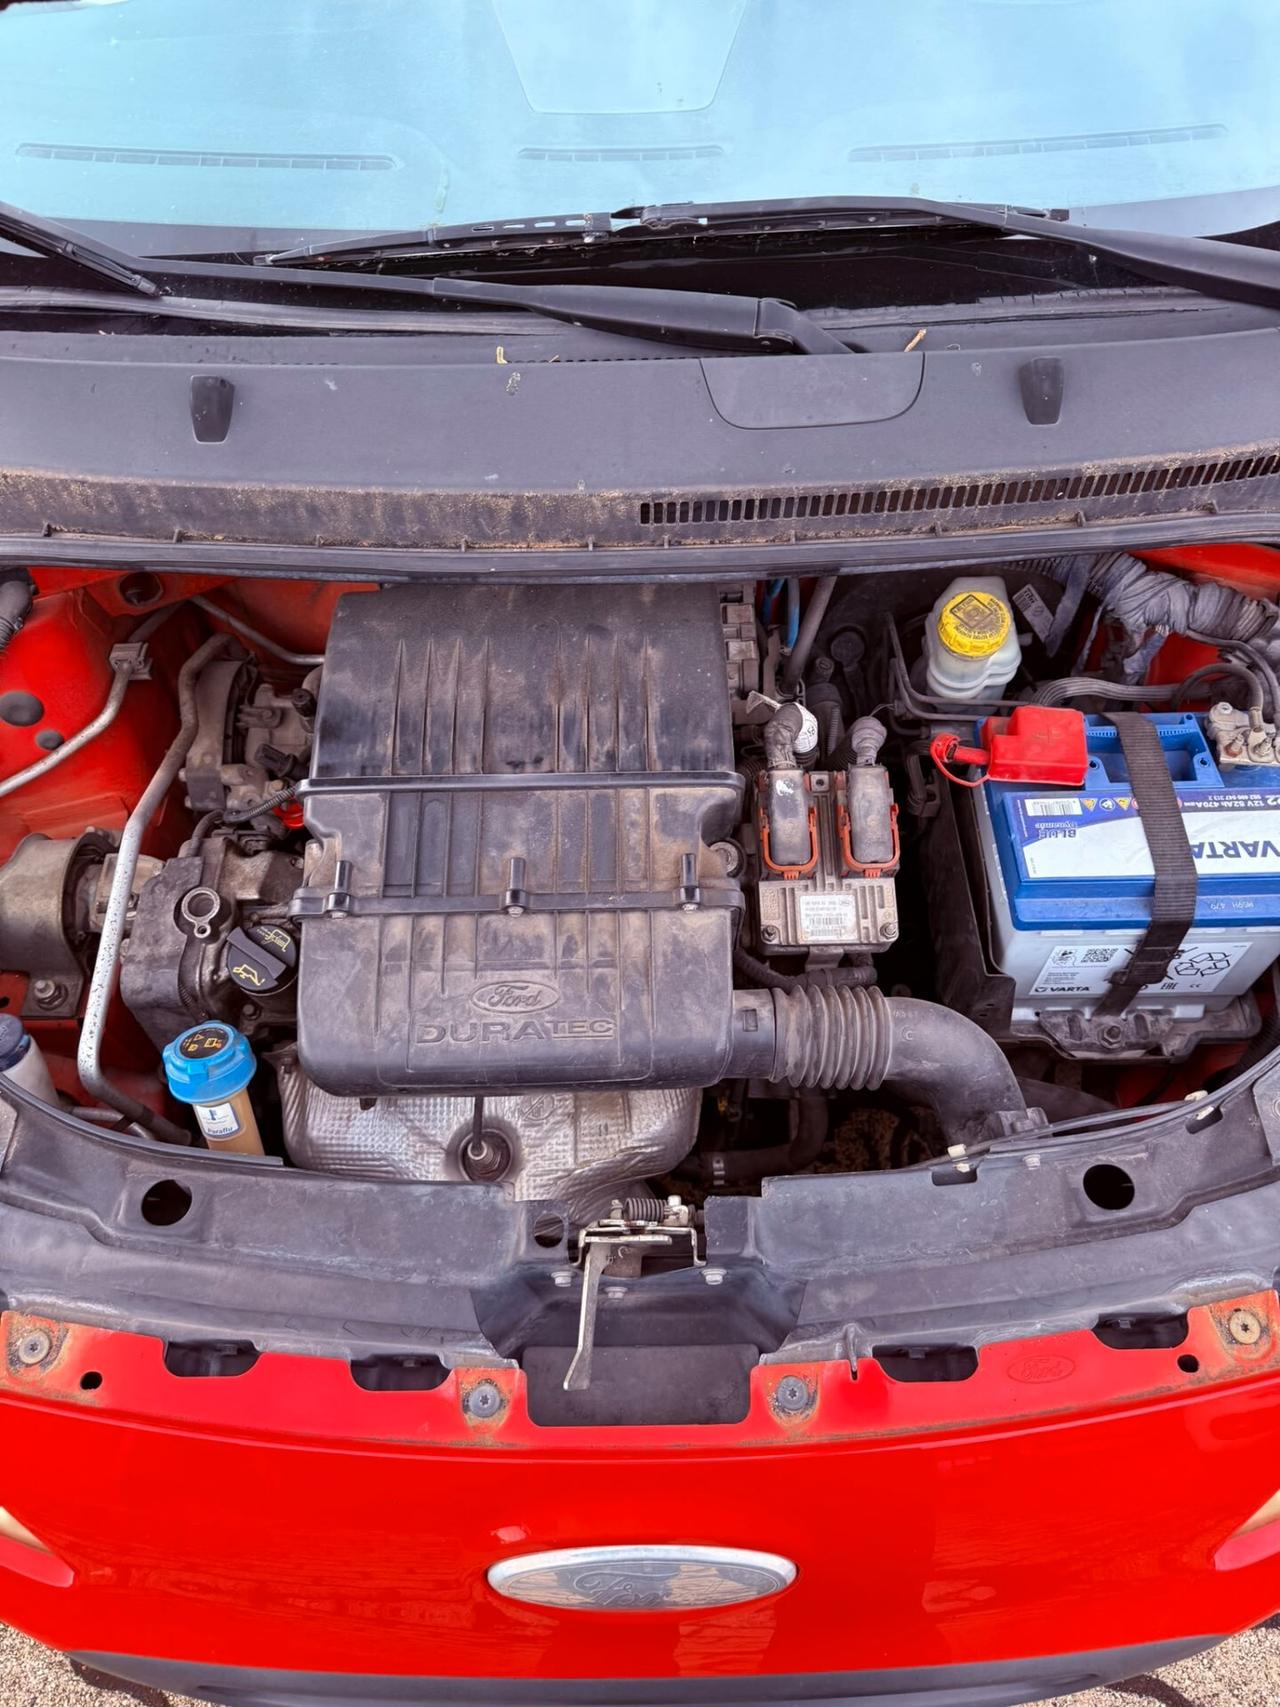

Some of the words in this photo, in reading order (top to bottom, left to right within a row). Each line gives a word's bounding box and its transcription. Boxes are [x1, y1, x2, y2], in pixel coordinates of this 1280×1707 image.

[1038, 829, 1077, 839] BLUE
[1190, 841, 1280, 859] VARTA
[487, 983, 542, 1008] Ford
[415, 1019, 616, 1046] DURATEC
